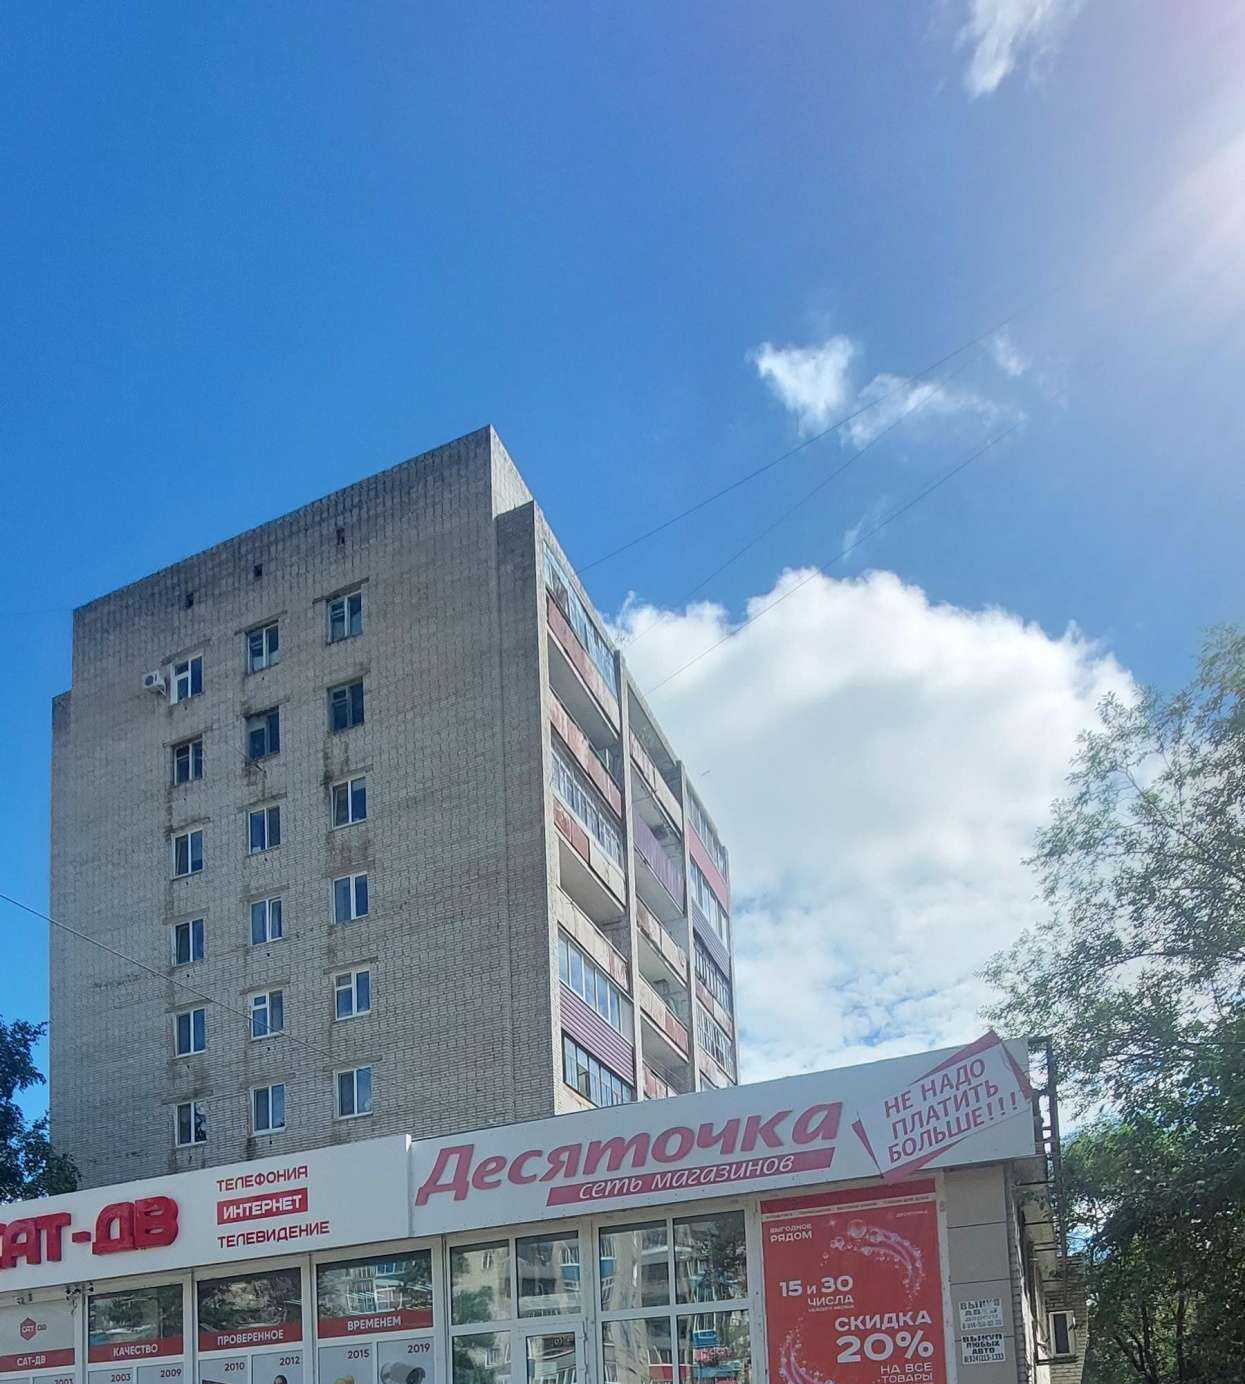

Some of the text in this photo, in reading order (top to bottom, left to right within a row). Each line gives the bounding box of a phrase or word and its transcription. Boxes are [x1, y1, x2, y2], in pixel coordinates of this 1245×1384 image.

[885, 1058, 986, 1118] НЕ НАДО
[891, 1080, 999, 1140] ПЛАТИТЬ
[888, 1091, 1018, 1164] БОЛЬШЕ!!!
[415, 1101, 843, 1206] Десяточка
[216, 1165, 309, 1192] ТЕЛЕФОНИЯ
[579, 1153, 795, 1200] сеть магазинов
[223, 1195, 302, 1220] ИНТЕРНЕТ
[0, 1196, 179, 1269] АТ-ДВ
[217, 1220, 330, 1249] ТЕЛЕВИДЕНИЕ
[769, 1223, 813, 1234] ВЫГОДНОЕ
[770, 1231, 813, 1243] РЯДОМ
[779, 1280, 803, 1297] 15
[821, 1275, 854, 1293] 30
[807, 1294, 854, 1307] ЧИСЛА
[347, 1316, 401, 1331] ВРЕМЕНЕМ
[834, 1310, 932, 1332] СКИДКА
[217, 1329, 284, 1345] ПРОВЕРЕННОЕ
[113, 1344, 158, 1357] КАЧЕСТВО
[347, 1349, 370, 1359] 2015
[407, 1343, 431, 1354] 2019
[836, 1330, 934, 1364] 20%
[17, 1355, 46, 1367] САТ-ДВ
[224, 1361, 245, 1372] 2010
[279, 1355, 300, 1366] 2012
[160, 1368, 182, 1378] 2009
[880, 1362, 933, 1375] НА ВСЕ
[111, 1373, 131, 1383] 2003
[881, 1374, 933, 1384] ТОВАРЫ
